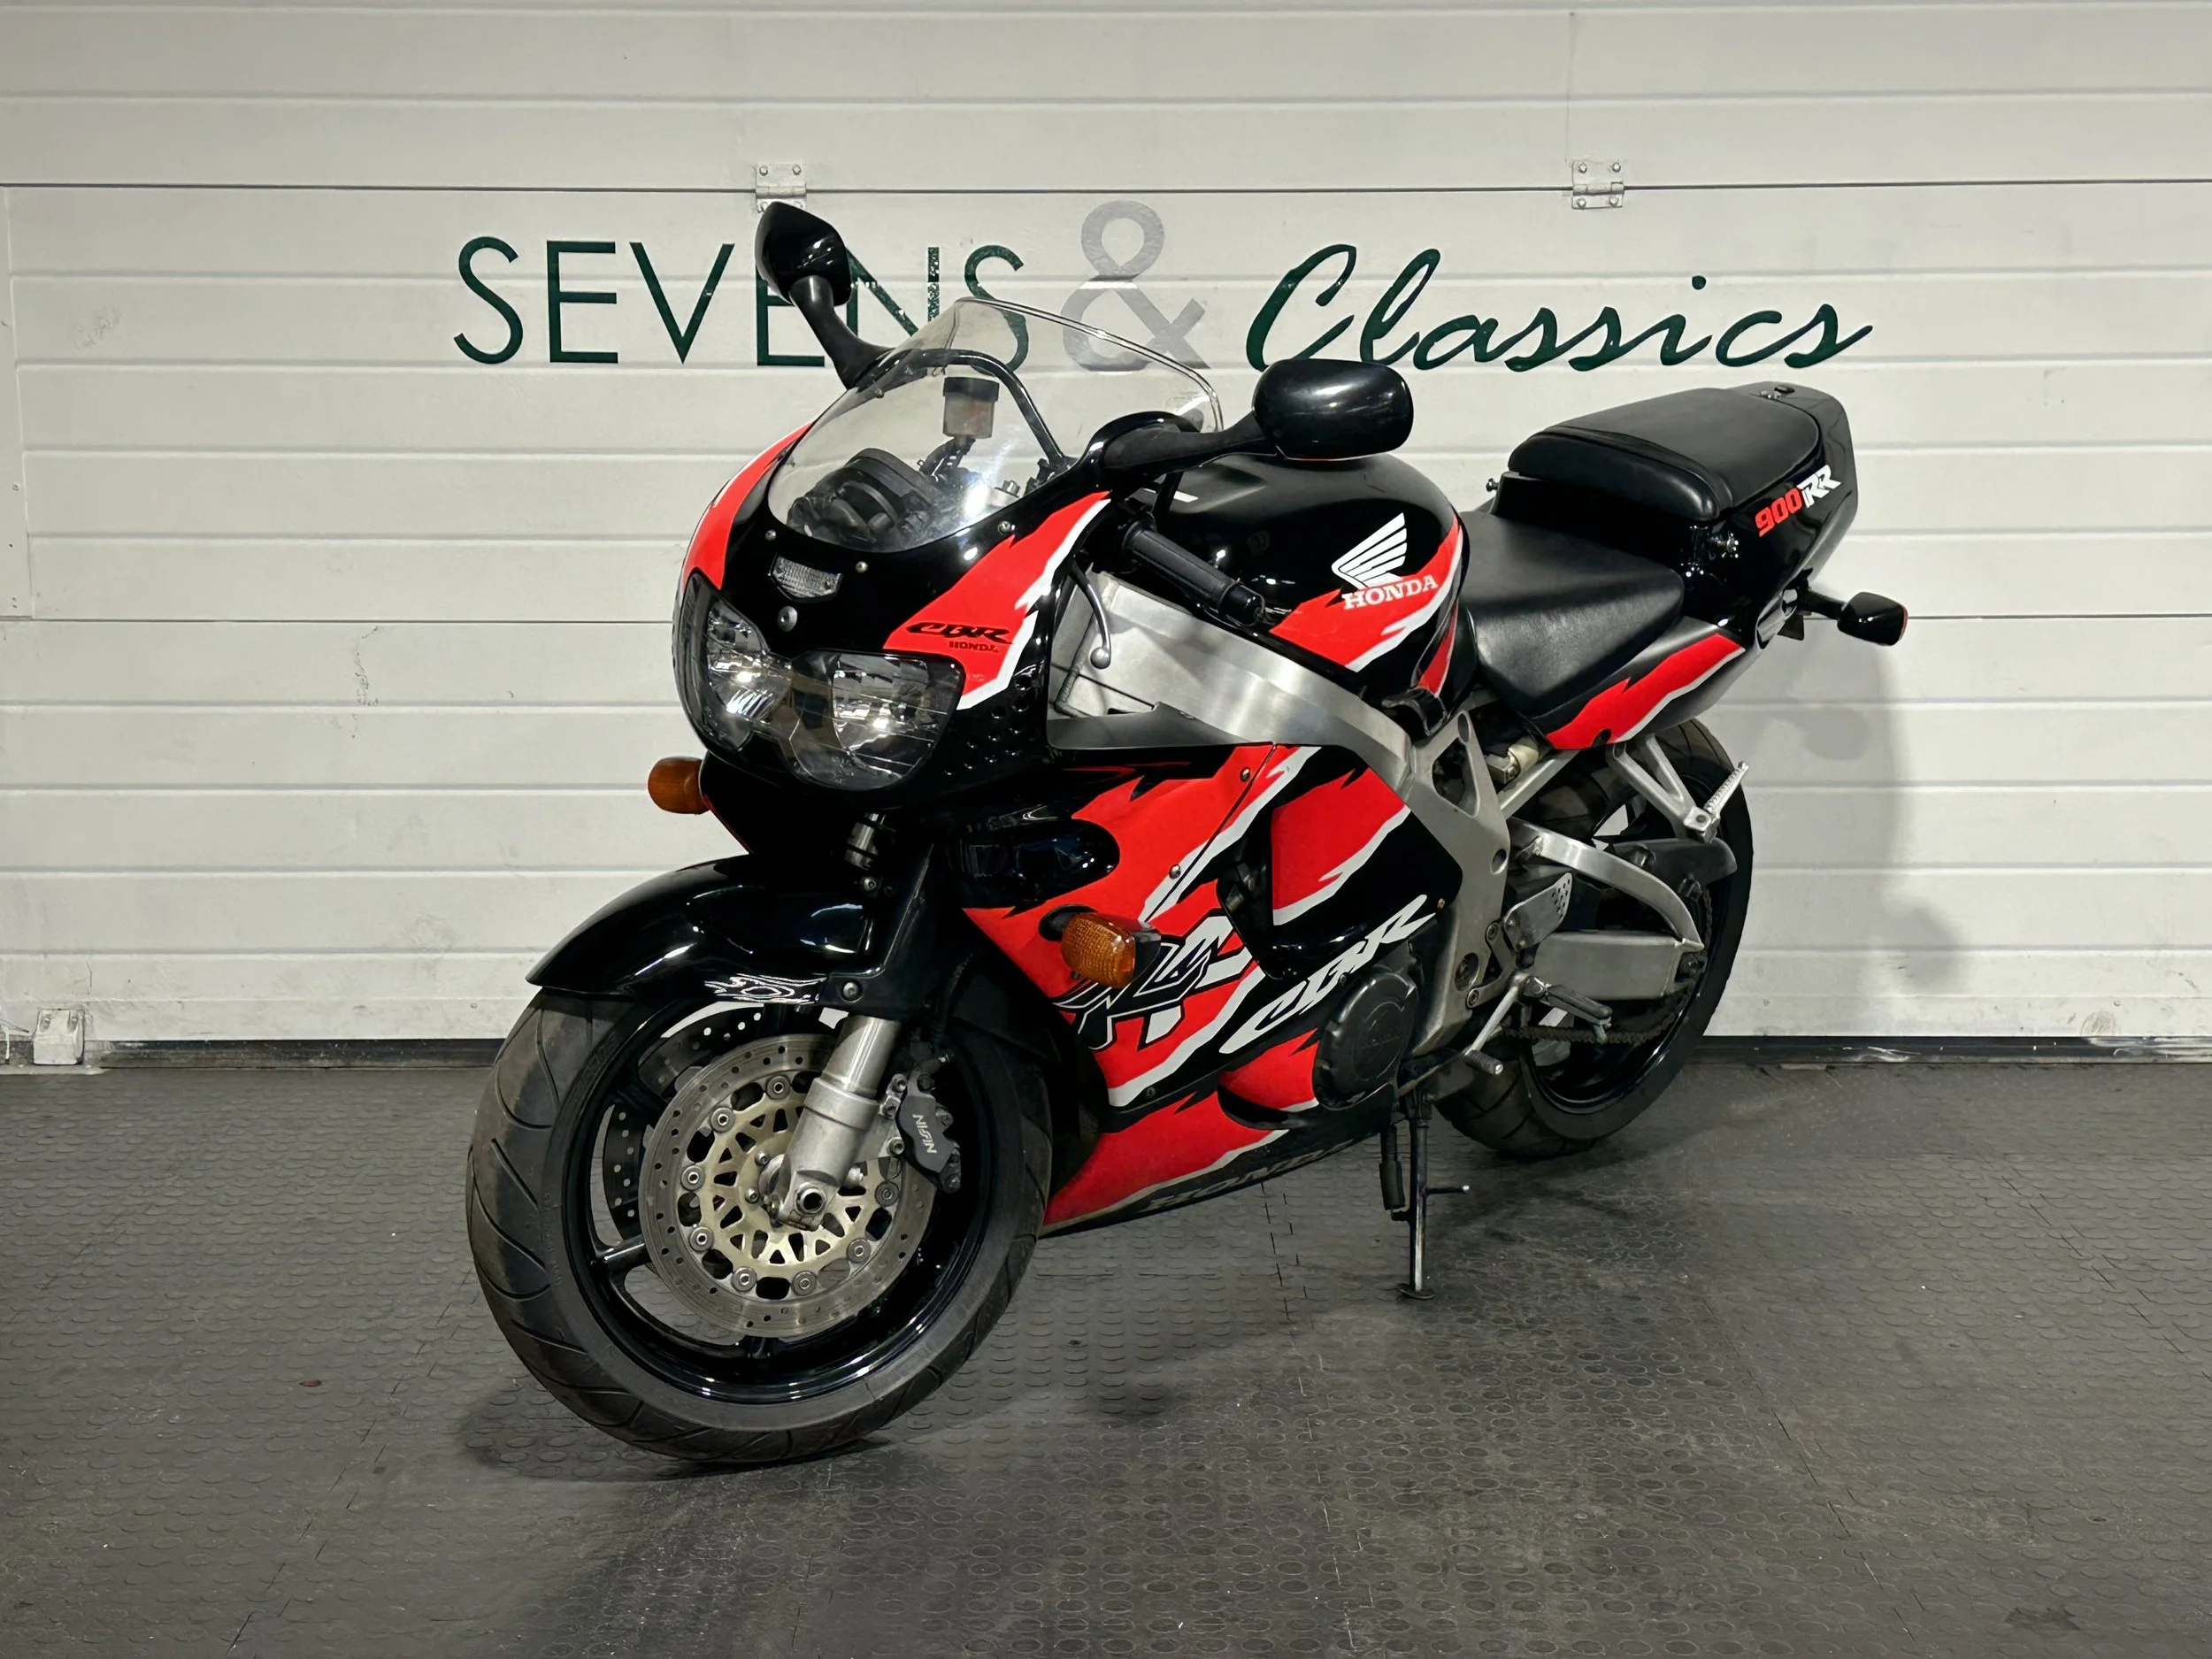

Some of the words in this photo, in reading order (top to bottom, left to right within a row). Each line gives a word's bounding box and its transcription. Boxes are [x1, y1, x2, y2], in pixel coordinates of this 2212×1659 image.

[1247, 243, 1874, 373] Classics
[1341, 575, 1439, 611] HONDA
[906, 622, 1013, 644] CBR
[949, 641, 1000, 653] HONDA
